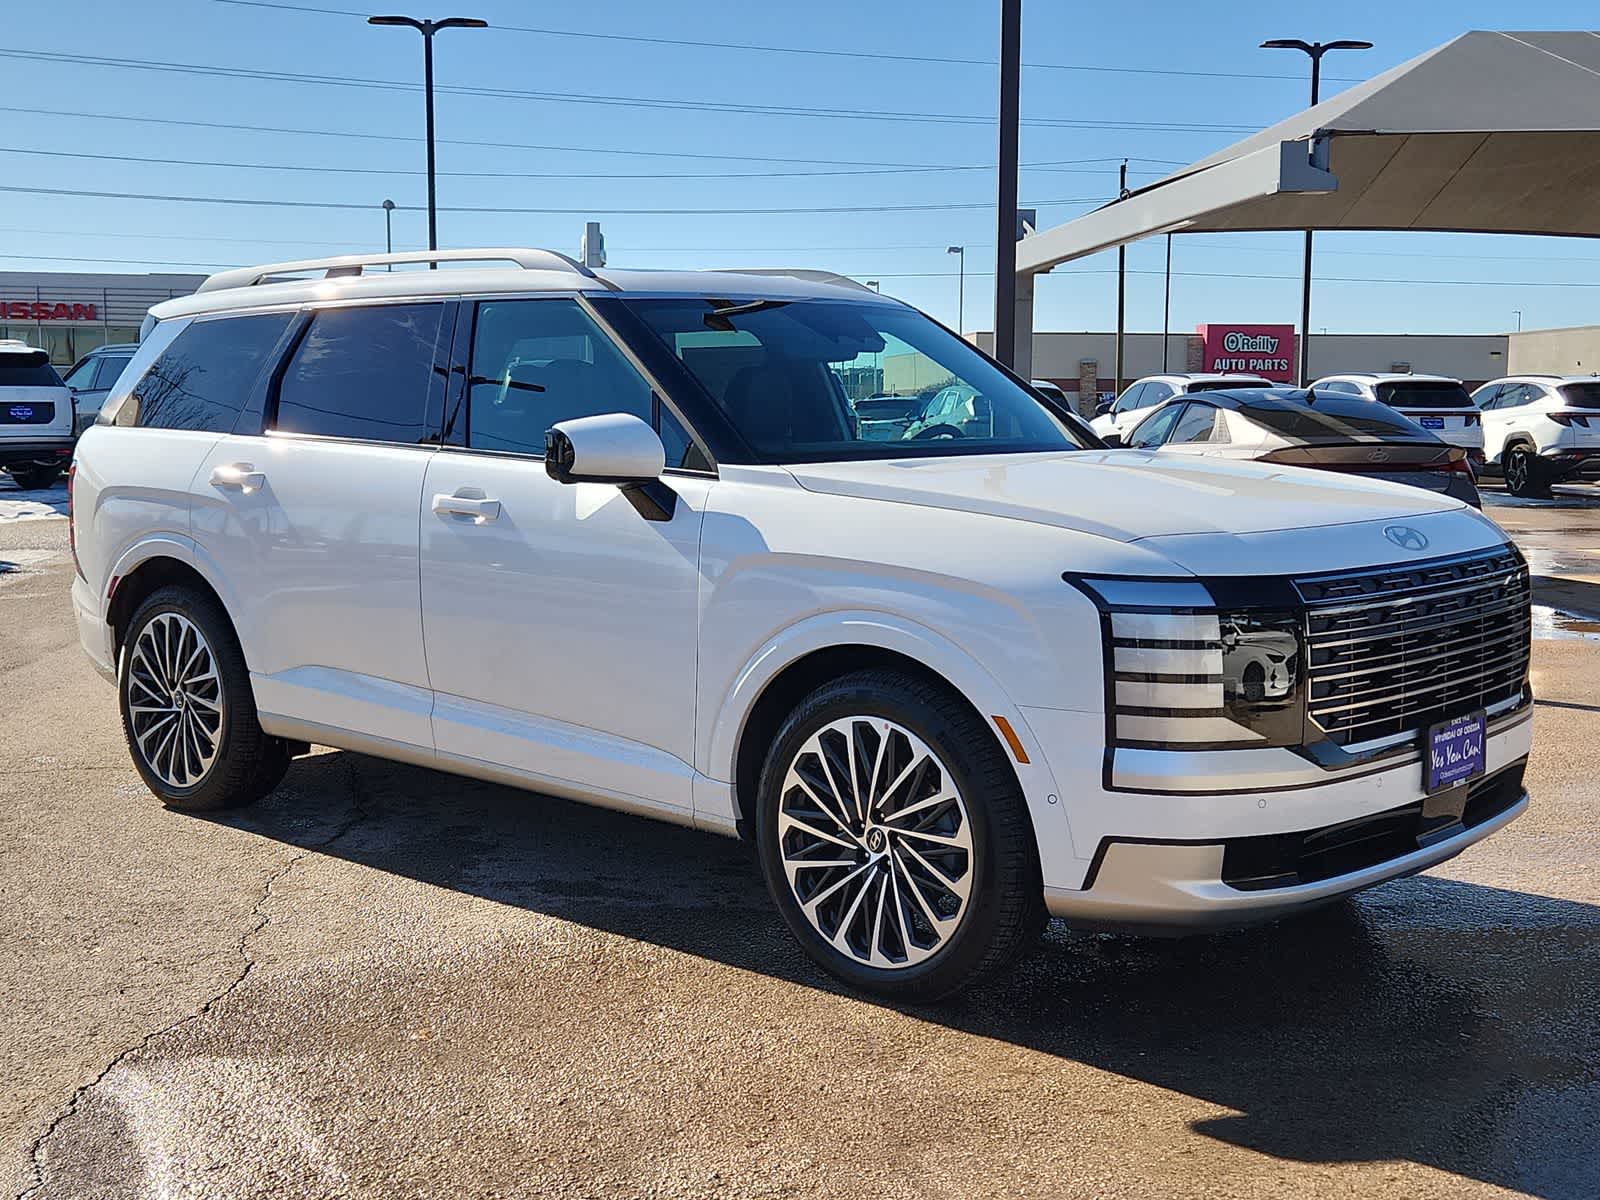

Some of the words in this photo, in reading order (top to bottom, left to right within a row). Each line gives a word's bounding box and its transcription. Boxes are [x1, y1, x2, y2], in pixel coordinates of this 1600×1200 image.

[0, 302, 96, 320] ISSAN
[1224, 332, 1279, 353] O'Reilly
[1214, 359, 1246, 371] AUTO
[1249, 359, 1288, 371] PARTS
[1432, 749, 1444, 770] Yes
[1446, 744, 1461, 765] You
[1463, 733, 1482, 760] Can!
